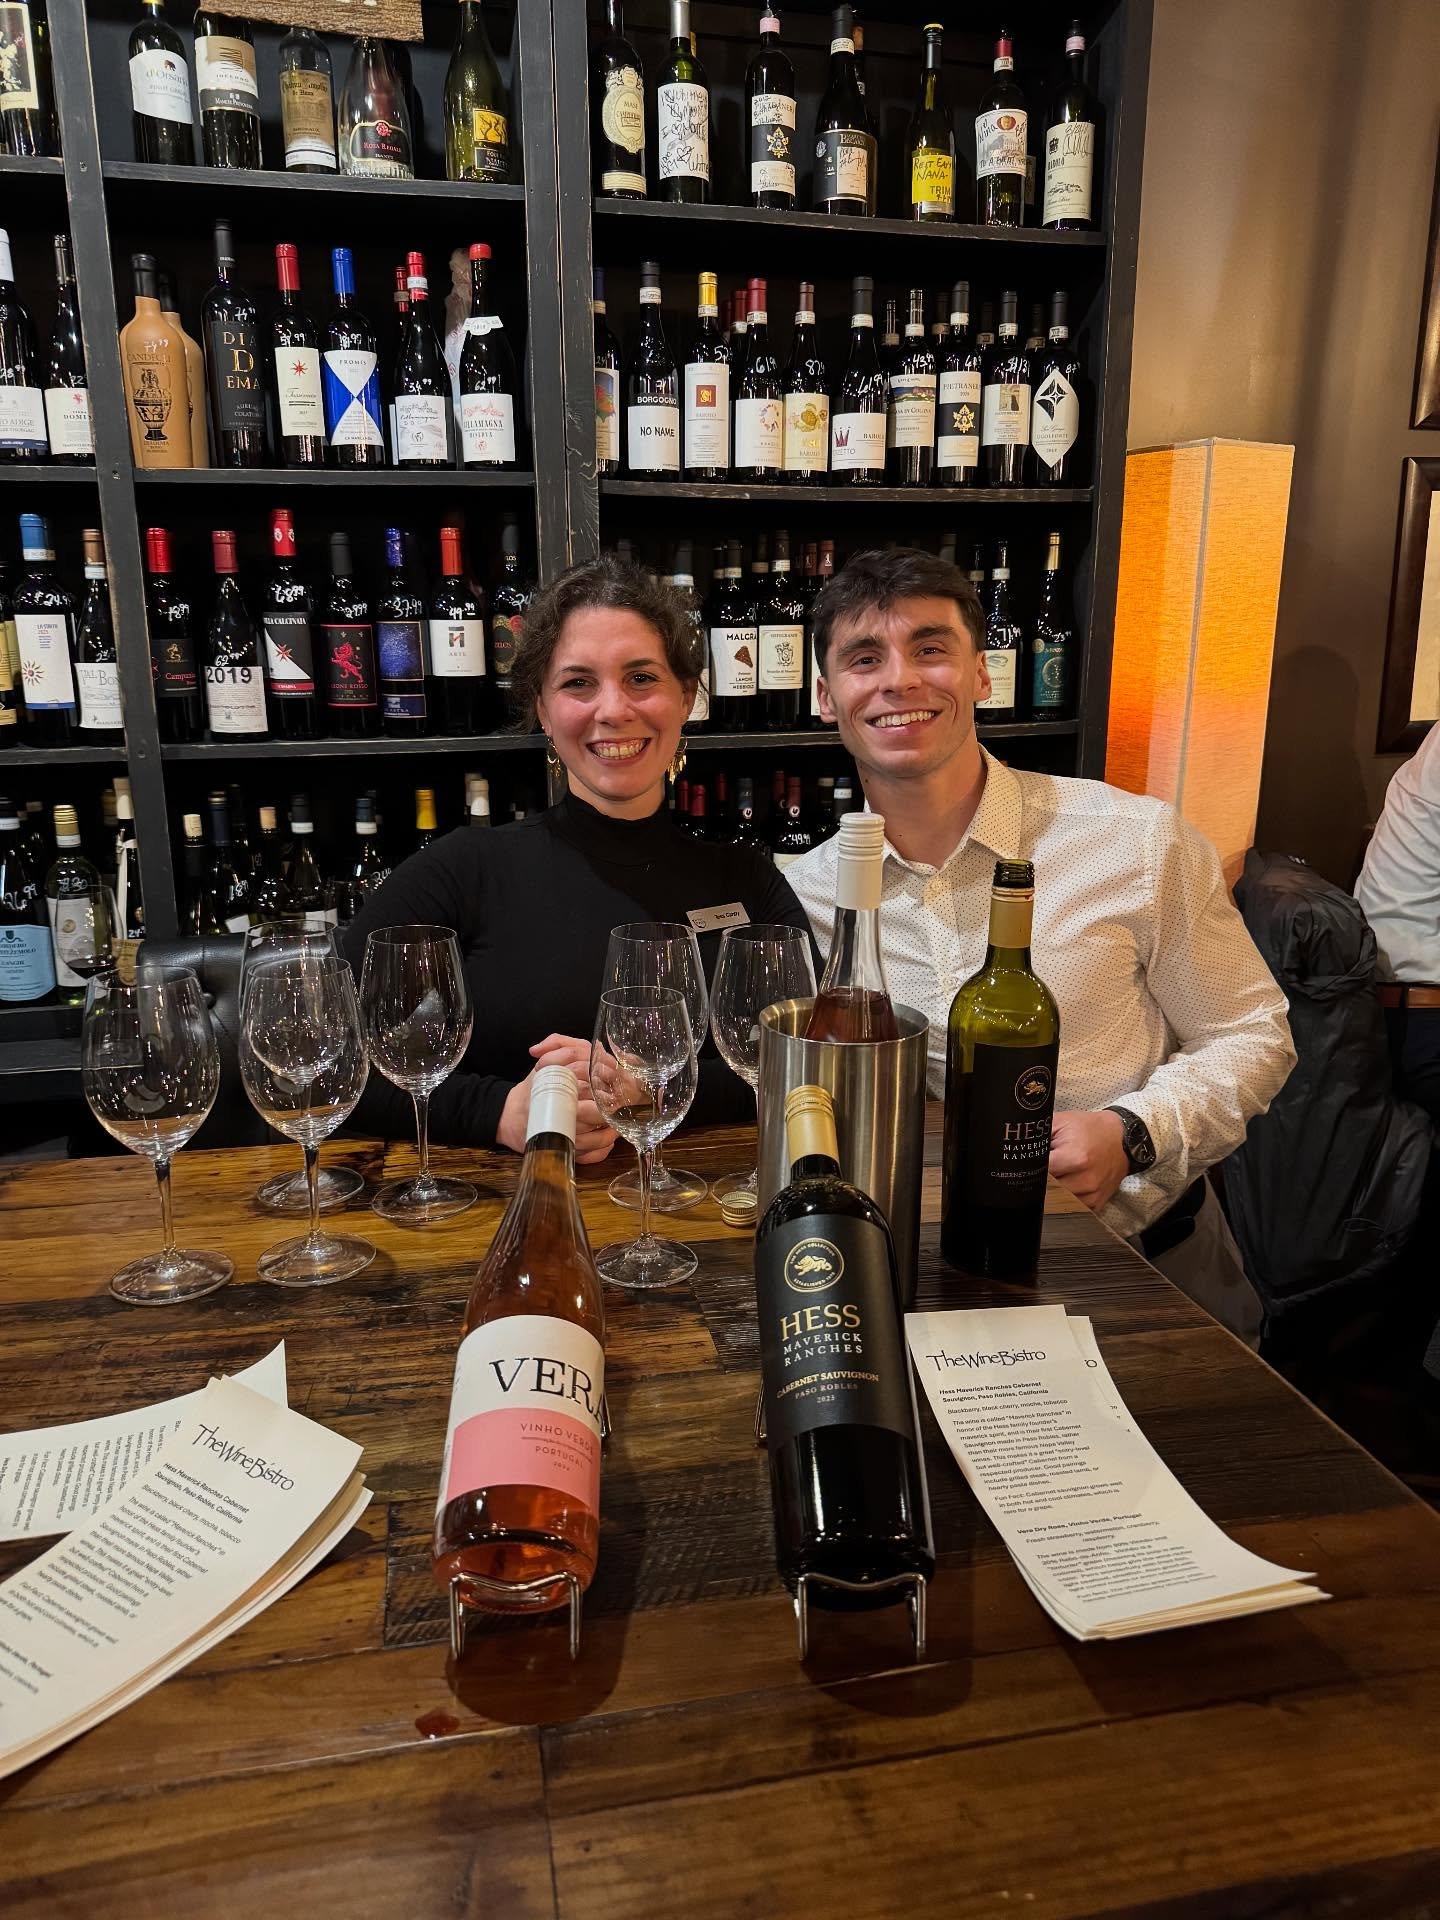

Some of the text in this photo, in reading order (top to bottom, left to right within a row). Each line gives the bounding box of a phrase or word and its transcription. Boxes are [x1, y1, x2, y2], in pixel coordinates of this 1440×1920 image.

[637, 396, 677, 405] BORGOGNO
[640, 426, 675, 437] NO NAME
[206, 667, 252, 685] 2019
[1003, 1116, 1051, 1141] HESS
[780, 1303, 861, 1342] HESS
[783, 1332, 863, 1355] MAVERICK
[784, 1344, 864, 1367] RANCHES
[777, 1371, 880, 1399] CABERNET SAUVIGNON
[795, 1384, 858, 1400] PASO ROBLES
[943, 1395, 977, 1404] Sauvignon,
[521, 1423, 563, 1436] VINHO
